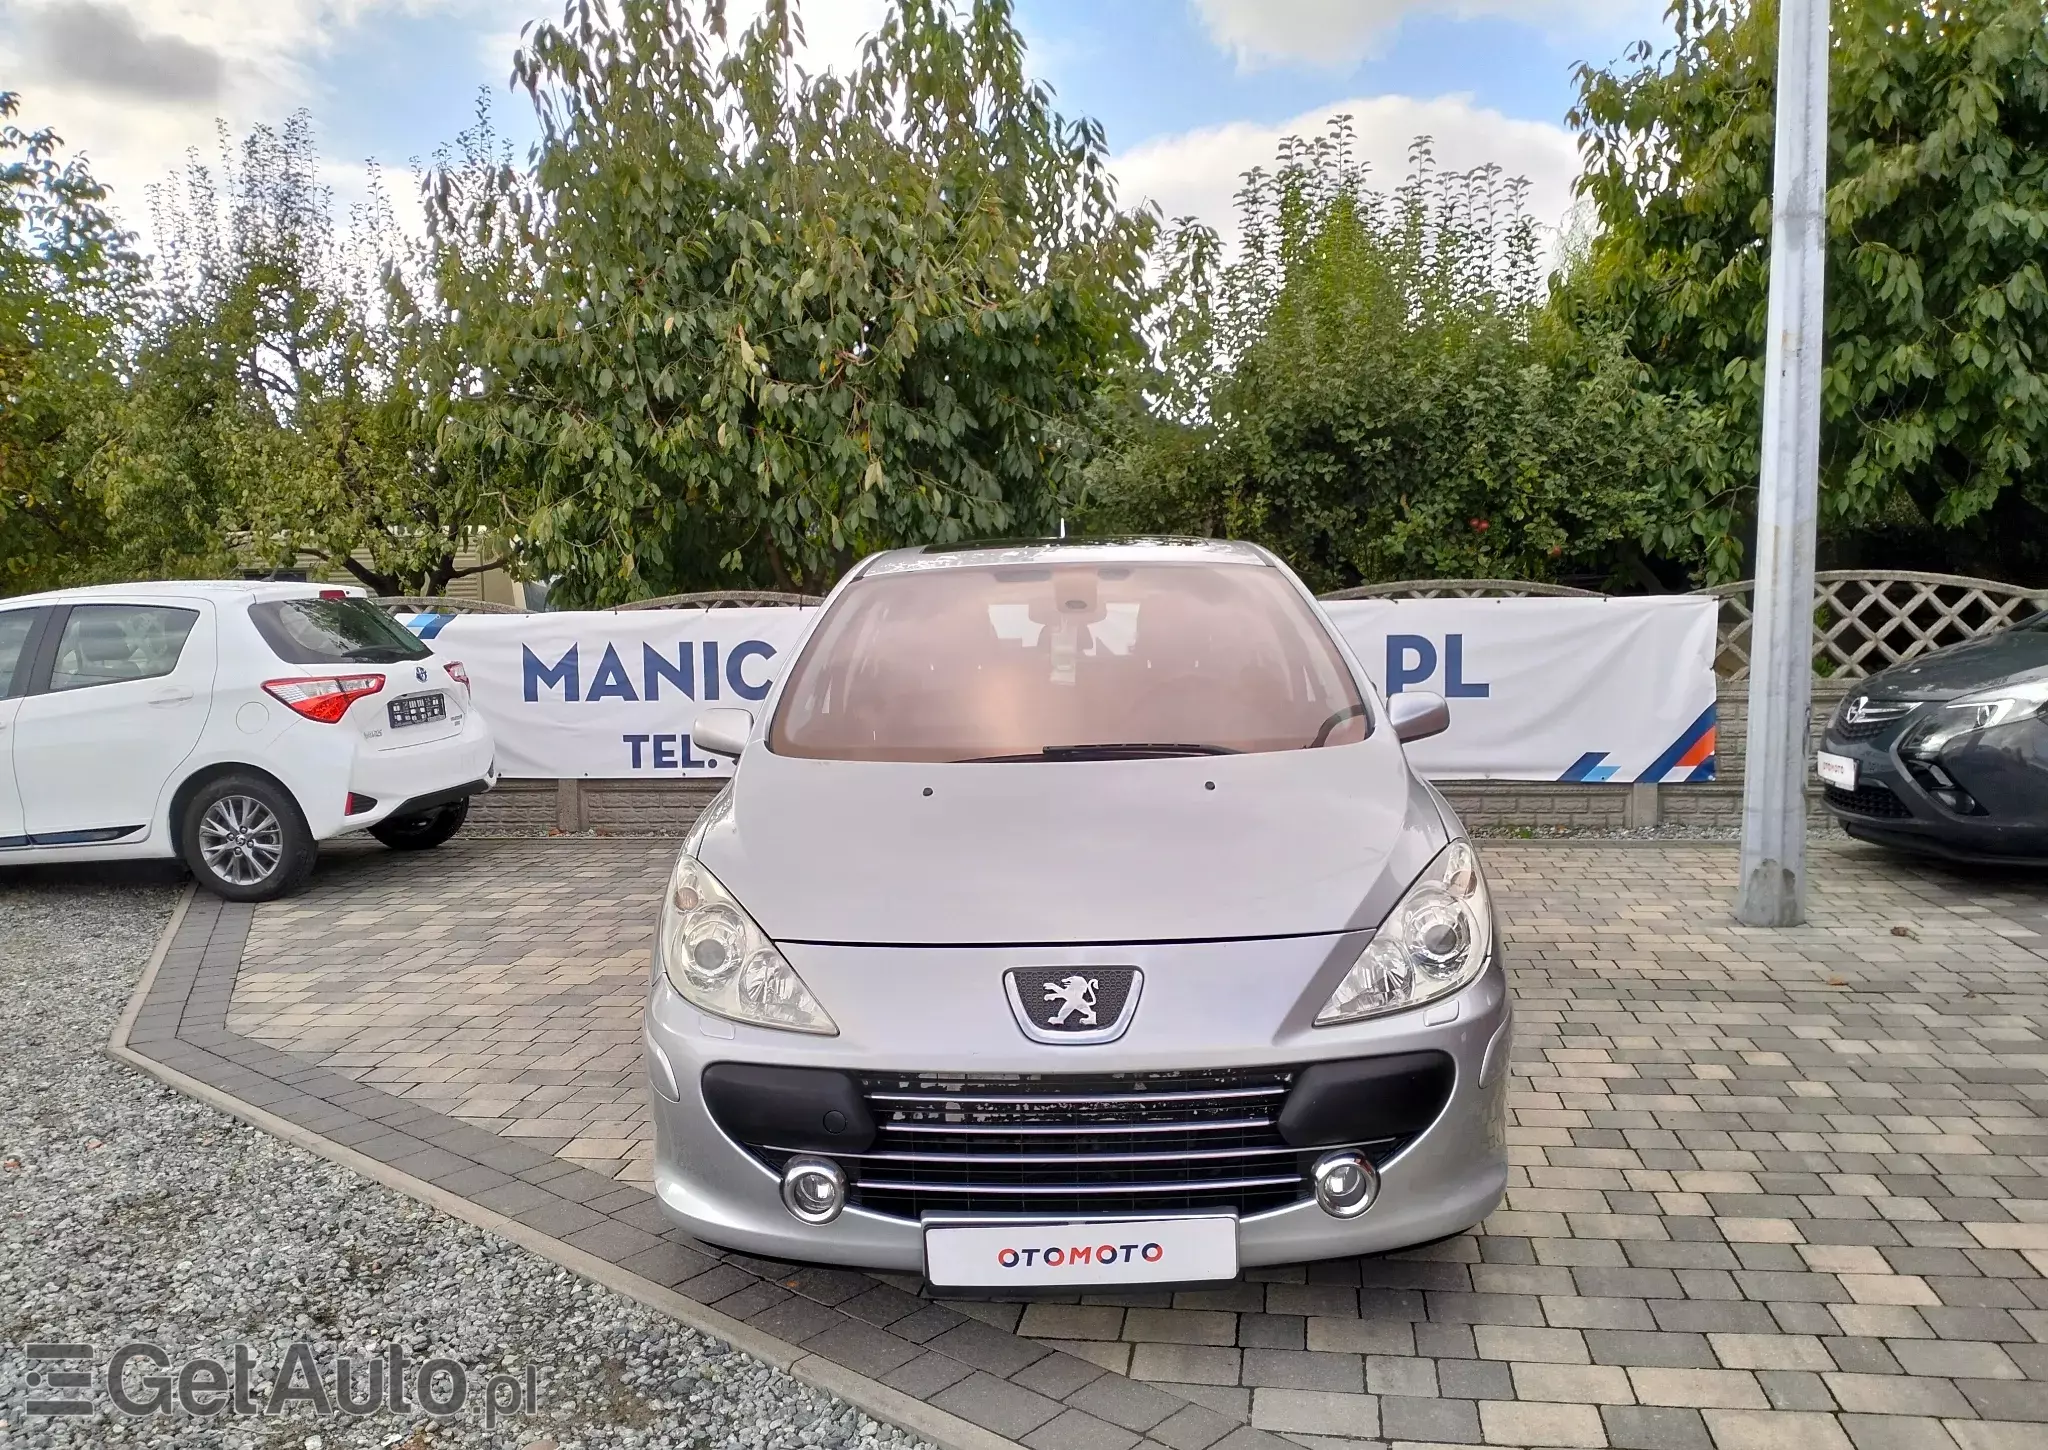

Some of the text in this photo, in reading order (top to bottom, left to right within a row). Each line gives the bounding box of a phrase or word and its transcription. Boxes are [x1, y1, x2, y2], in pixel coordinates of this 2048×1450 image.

[1386, 633, 1490, 698] PL
[622, 734, 718, 769] TEL.
[997, 1242, 1164, 1268] OTOMOTO
